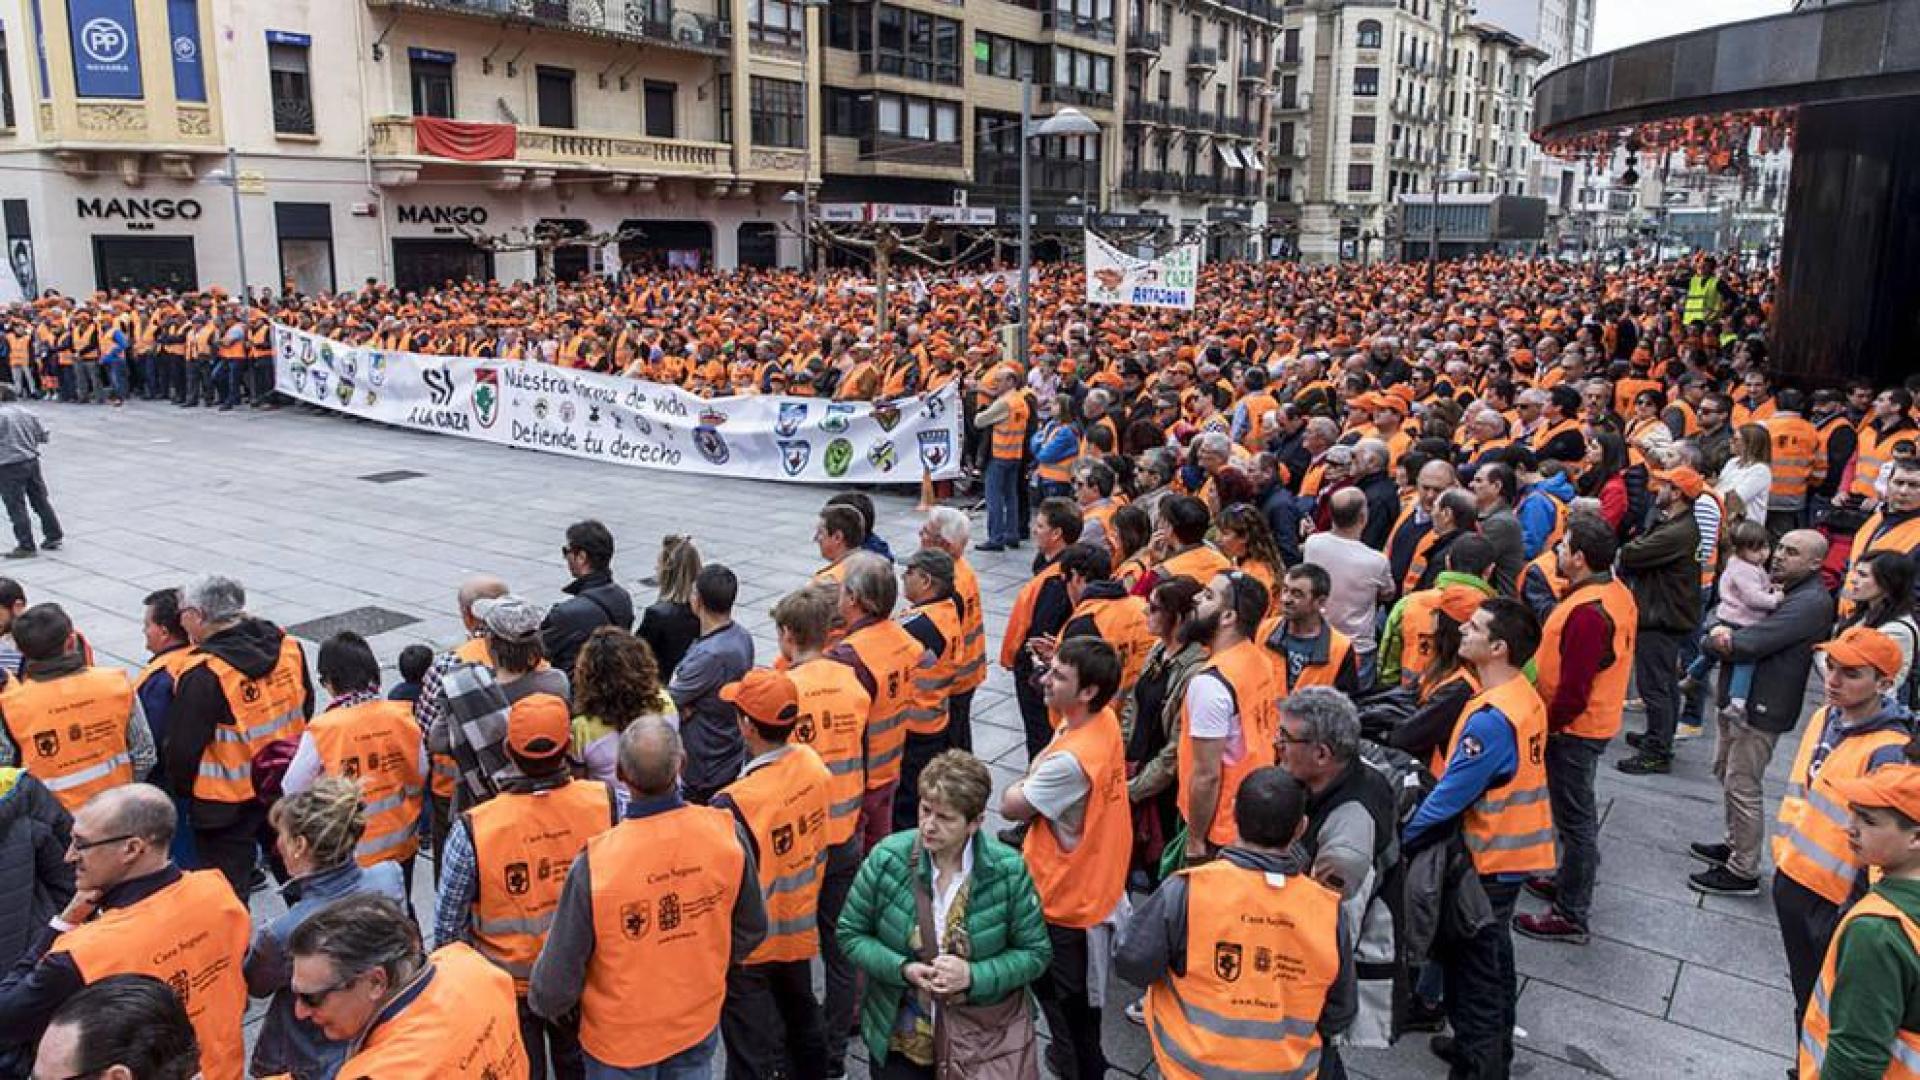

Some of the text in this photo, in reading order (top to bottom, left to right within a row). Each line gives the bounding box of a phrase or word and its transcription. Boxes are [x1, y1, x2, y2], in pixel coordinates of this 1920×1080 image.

[76, 198, 202, 219] MANGO
[397, 205, 488, 225] MANGO
[624, 384, 646, 408] de
[653, 391, 687, 416] vida
[436, 411, 470, 432] CAZA
[511, 419, 682, 466] Defiende tu derecho
